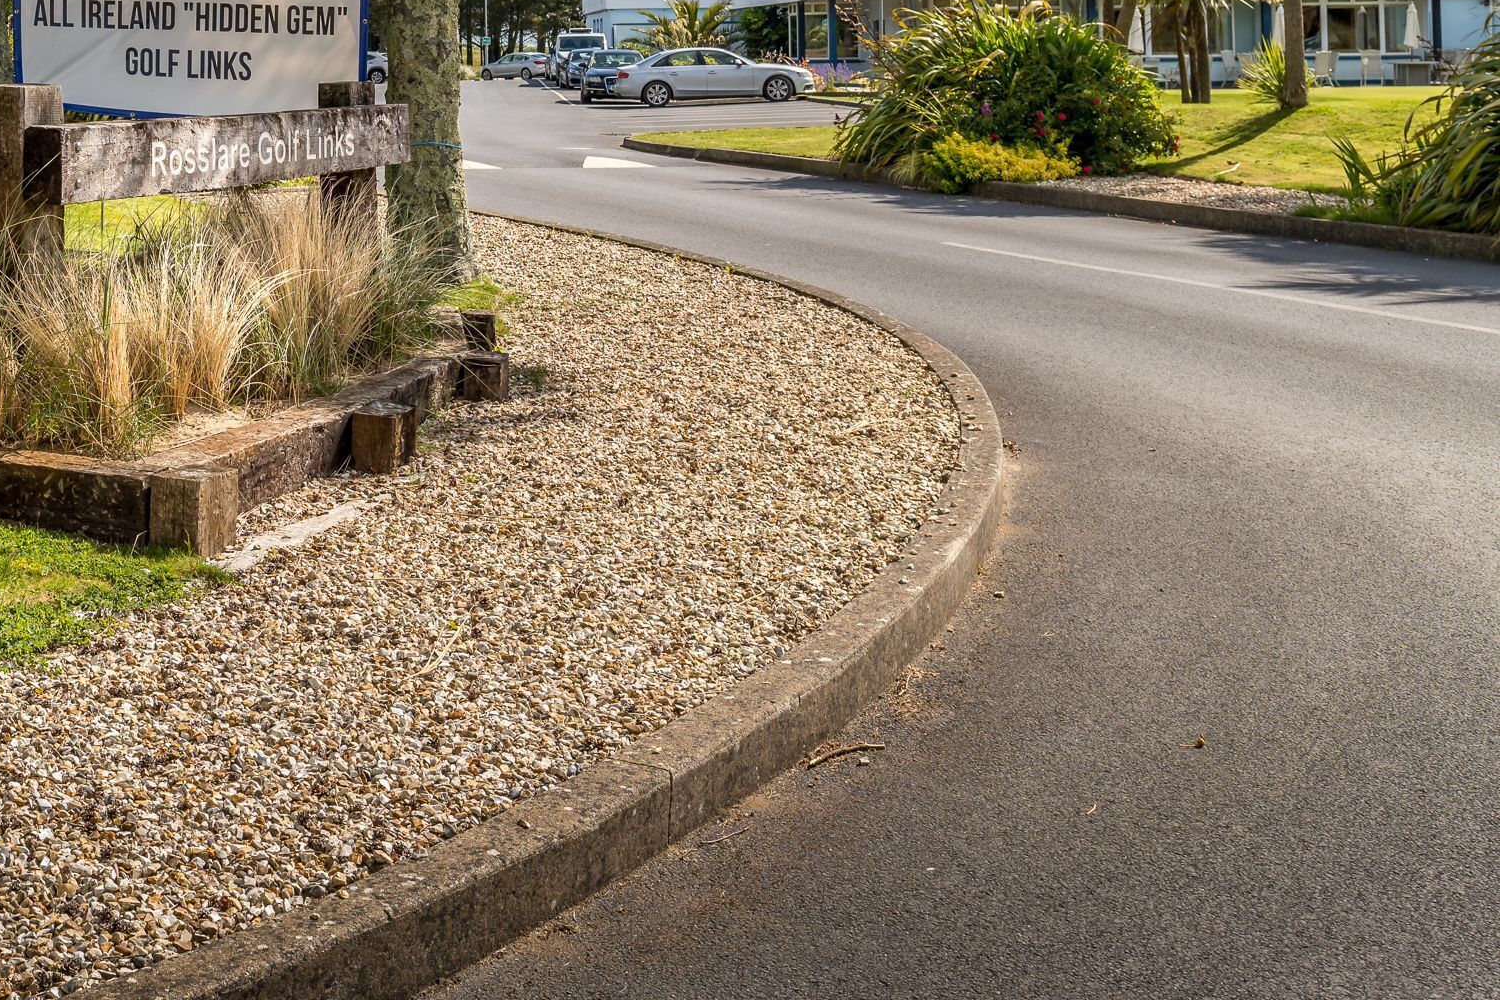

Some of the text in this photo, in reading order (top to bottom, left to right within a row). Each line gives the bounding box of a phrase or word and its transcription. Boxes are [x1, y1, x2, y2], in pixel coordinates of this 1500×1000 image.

[81, 0, 176, 31] IRELAND
[183, 2, 279, 34] "HIDDEN
[287, 4, 348, 36] GEM"
[125, 46, 252, 81] GOLF LINKS
[150, 126, 355, 178] Rosslare Golf Links
